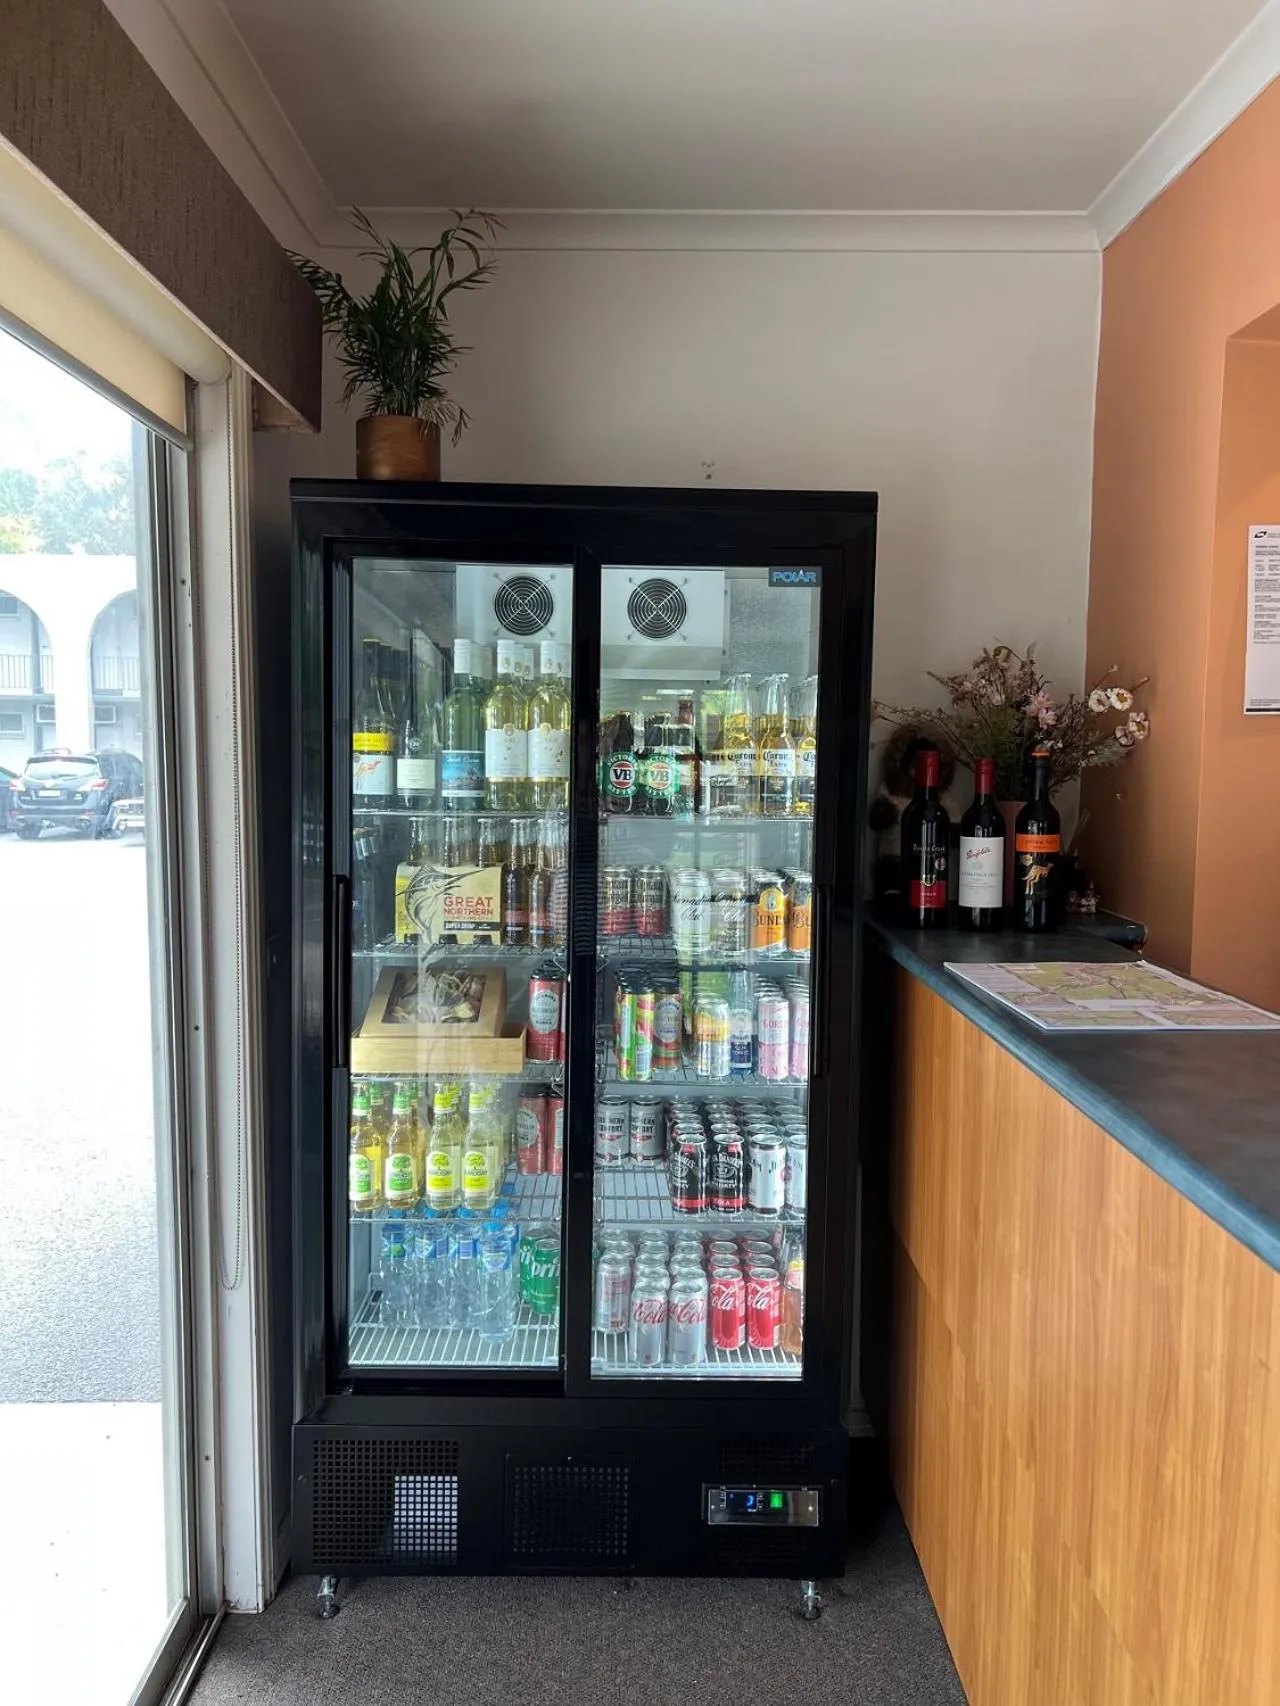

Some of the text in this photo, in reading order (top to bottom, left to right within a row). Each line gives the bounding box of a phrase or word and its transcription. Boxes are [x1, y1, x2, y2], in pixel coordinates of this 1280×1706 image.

[772, 569, 817, 583] POLAR
[612, 769, 632, 781] VB
[444, 896, 493, 907] GREAT
[444, 907, 493, 916] NORTHERN
